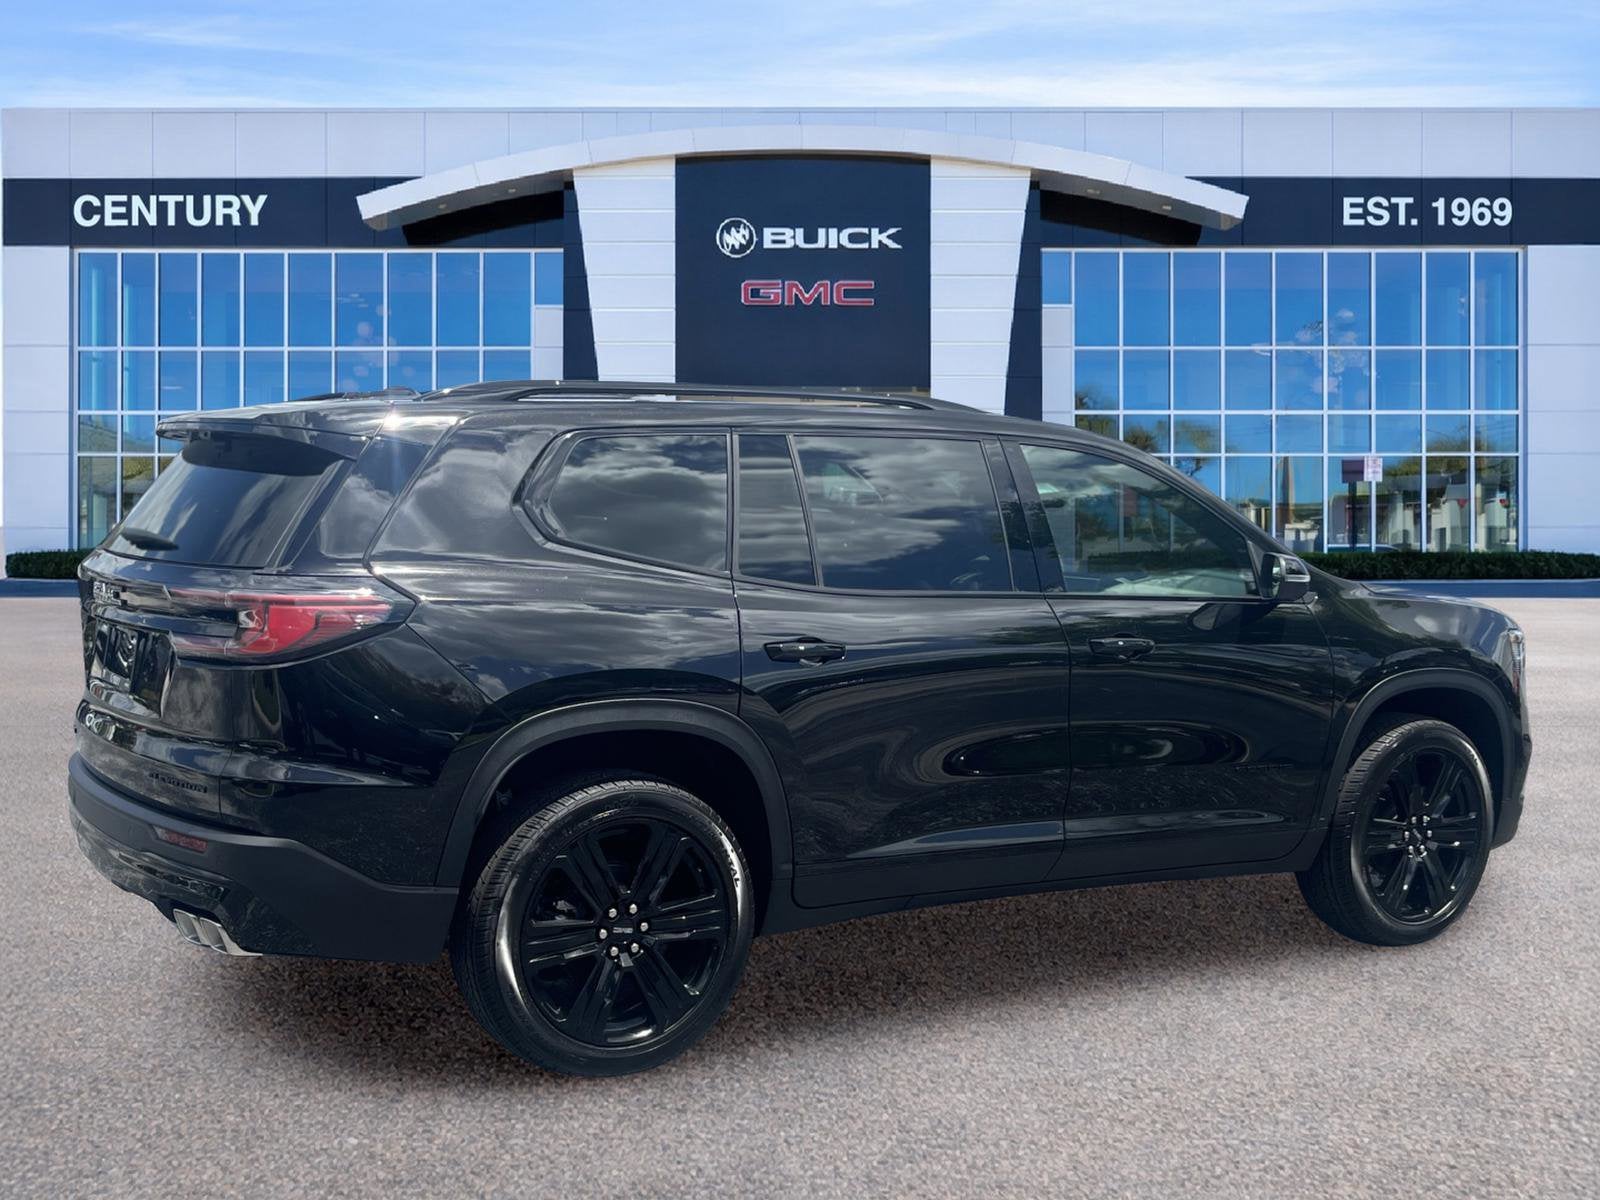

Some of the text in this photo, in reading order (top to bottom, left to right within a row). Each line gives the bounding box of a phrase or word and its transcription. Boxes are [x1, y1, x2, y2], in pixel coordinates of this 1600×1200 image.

[73, 194, 268, 227] CENTURY
[1343, 196, 1513, 226] EST. 1969
[763, 227, 902, 249] BUICK
[741, 280, 874, 305] GMC
